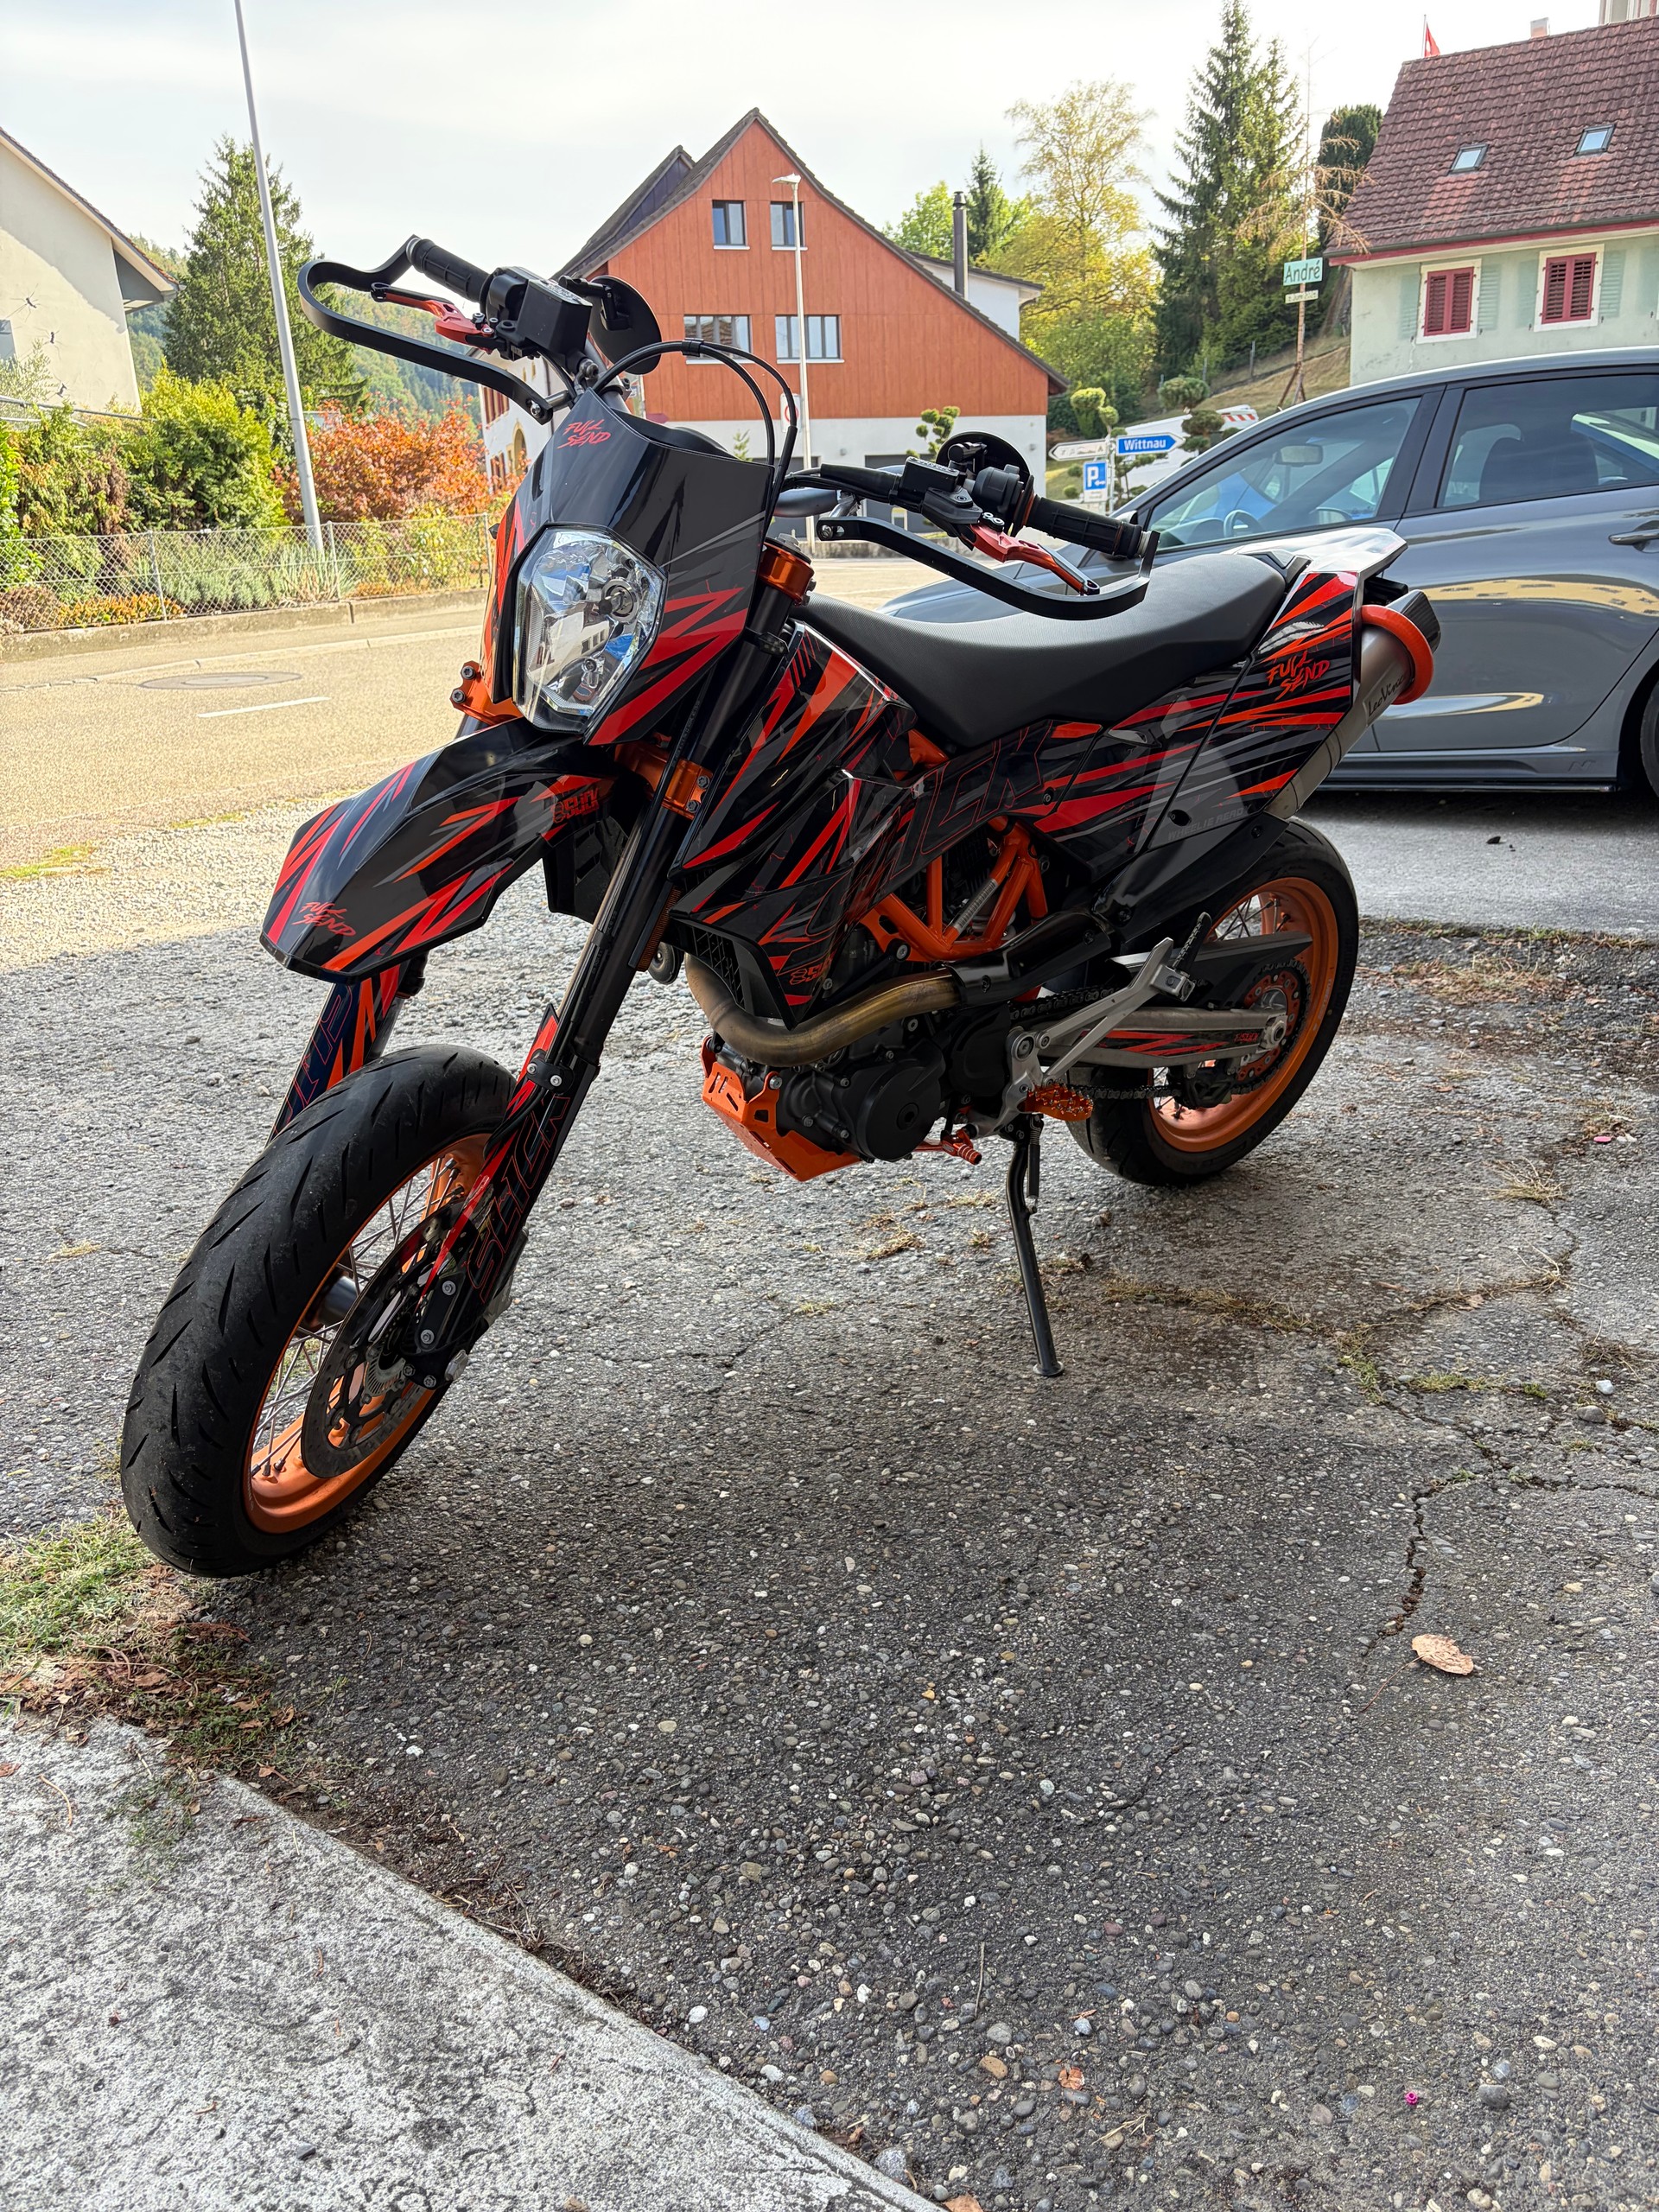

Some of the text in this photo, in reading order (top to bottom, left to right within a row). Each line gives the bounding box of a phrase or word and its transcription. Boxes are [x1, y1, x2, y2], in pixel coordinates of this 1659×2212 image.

[1284, 259, 1320, 283] André
[556, 431, 611, 449] SEND
[1124, 439, 1166, 451] Wittnau
[1087, 466, 1099, 487] P
[1274, 660, 1330, 701] SEND
[291, 913, 356, 937] SEND
